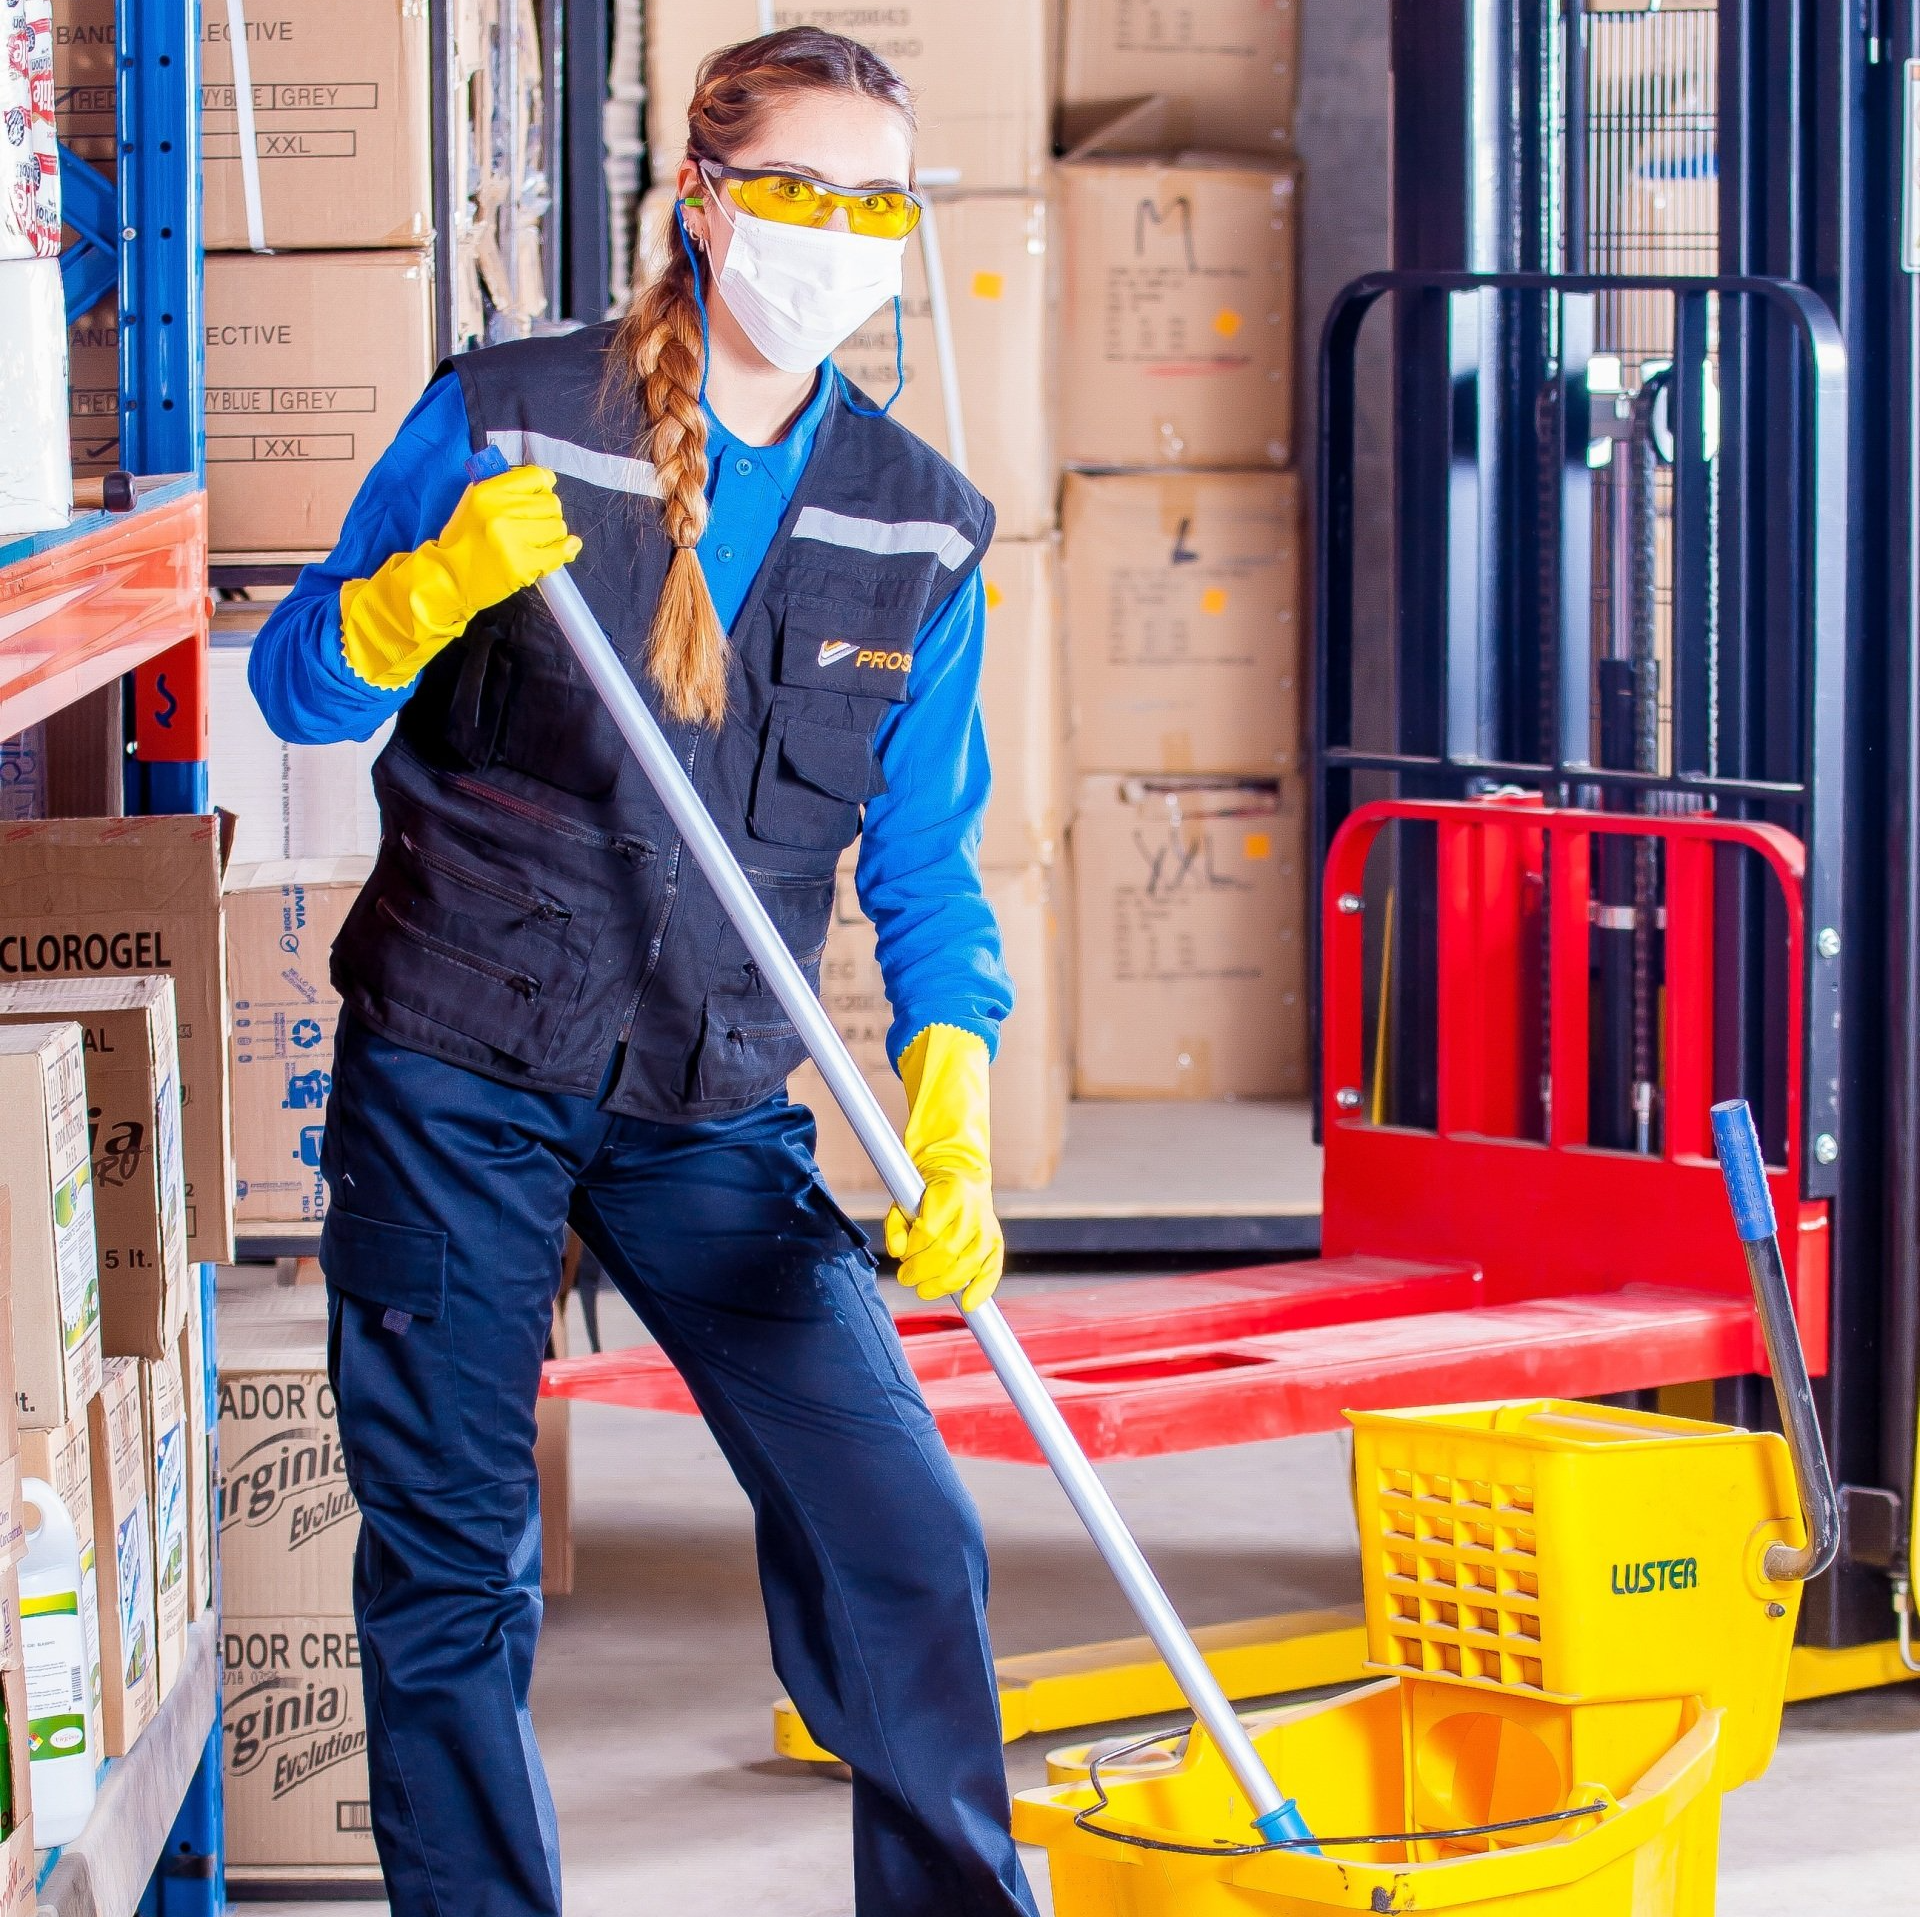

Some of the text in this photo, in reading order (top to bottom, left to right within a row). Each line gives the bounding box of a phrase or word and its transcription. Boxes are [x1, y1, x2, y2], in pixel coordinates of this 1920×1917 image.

[281, 87, 339, 106] GREY
[266, 135, 312, 155] XXL
[205, 325, 293, 346] ECTIVE
[280, 390, 338, 410] GREY
[264, 438, 310, 458] XXL
[0, 931, 172, 973] CLOROGEL
[105, 1250, 119, 1269] 5
[218, 1384, 307, 1420] ADOR
[1611, 1557, 1698, 1595] LUSTER
[225, 1633, 362, 1669] DOR CRE
[273, 1731, 366, 1792] Evolution
